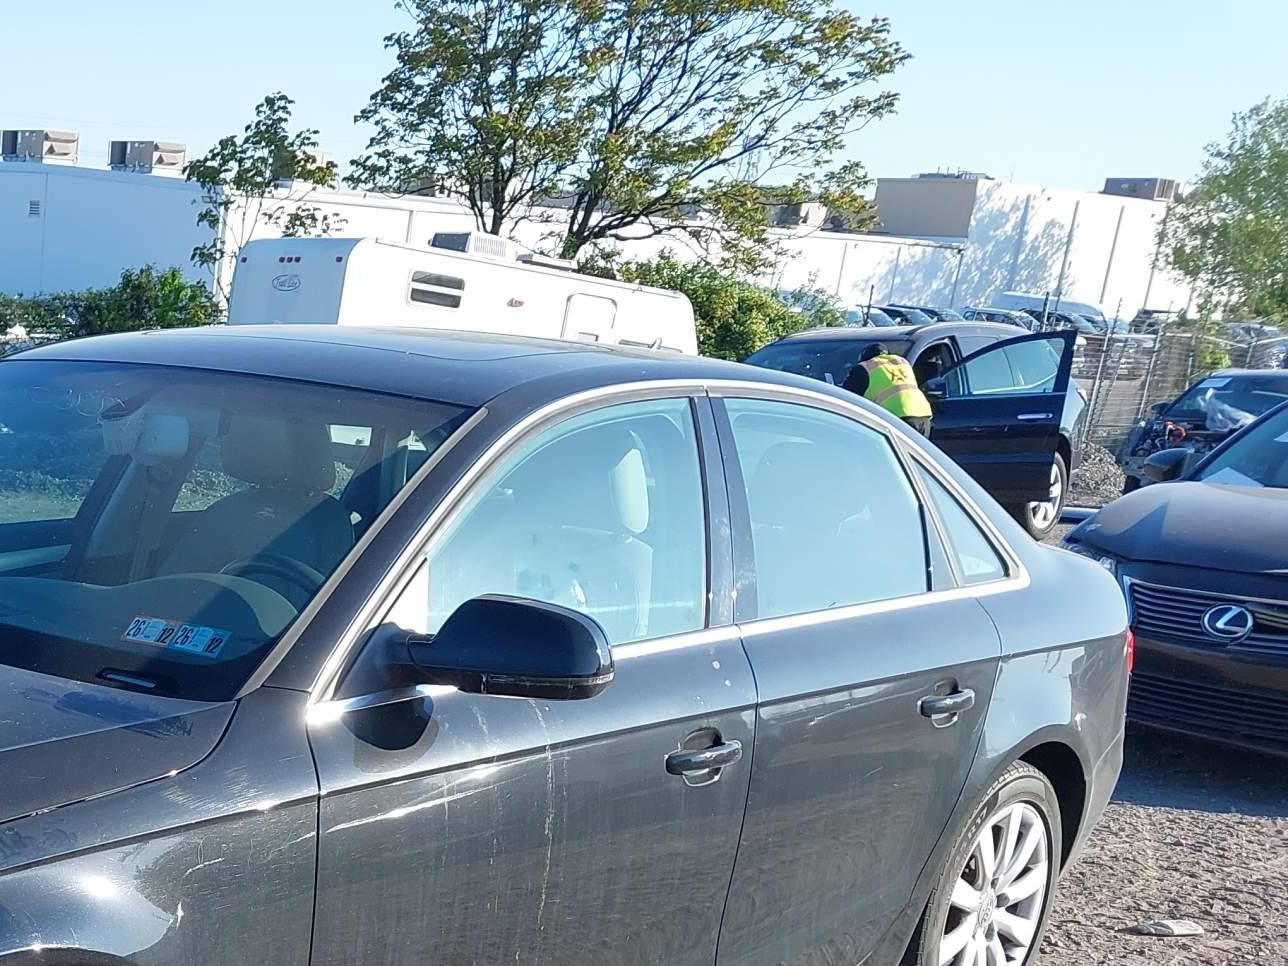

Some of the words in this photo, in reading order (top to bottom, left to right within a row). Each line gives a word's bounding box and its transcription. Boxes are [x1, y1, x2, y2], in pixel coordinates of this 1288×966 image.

[127, 619, 146, 637] 26
[157, 627, 175, 643] 12
[174, 627, 194, 646] 26
[205, 637, 223, 654] 12
